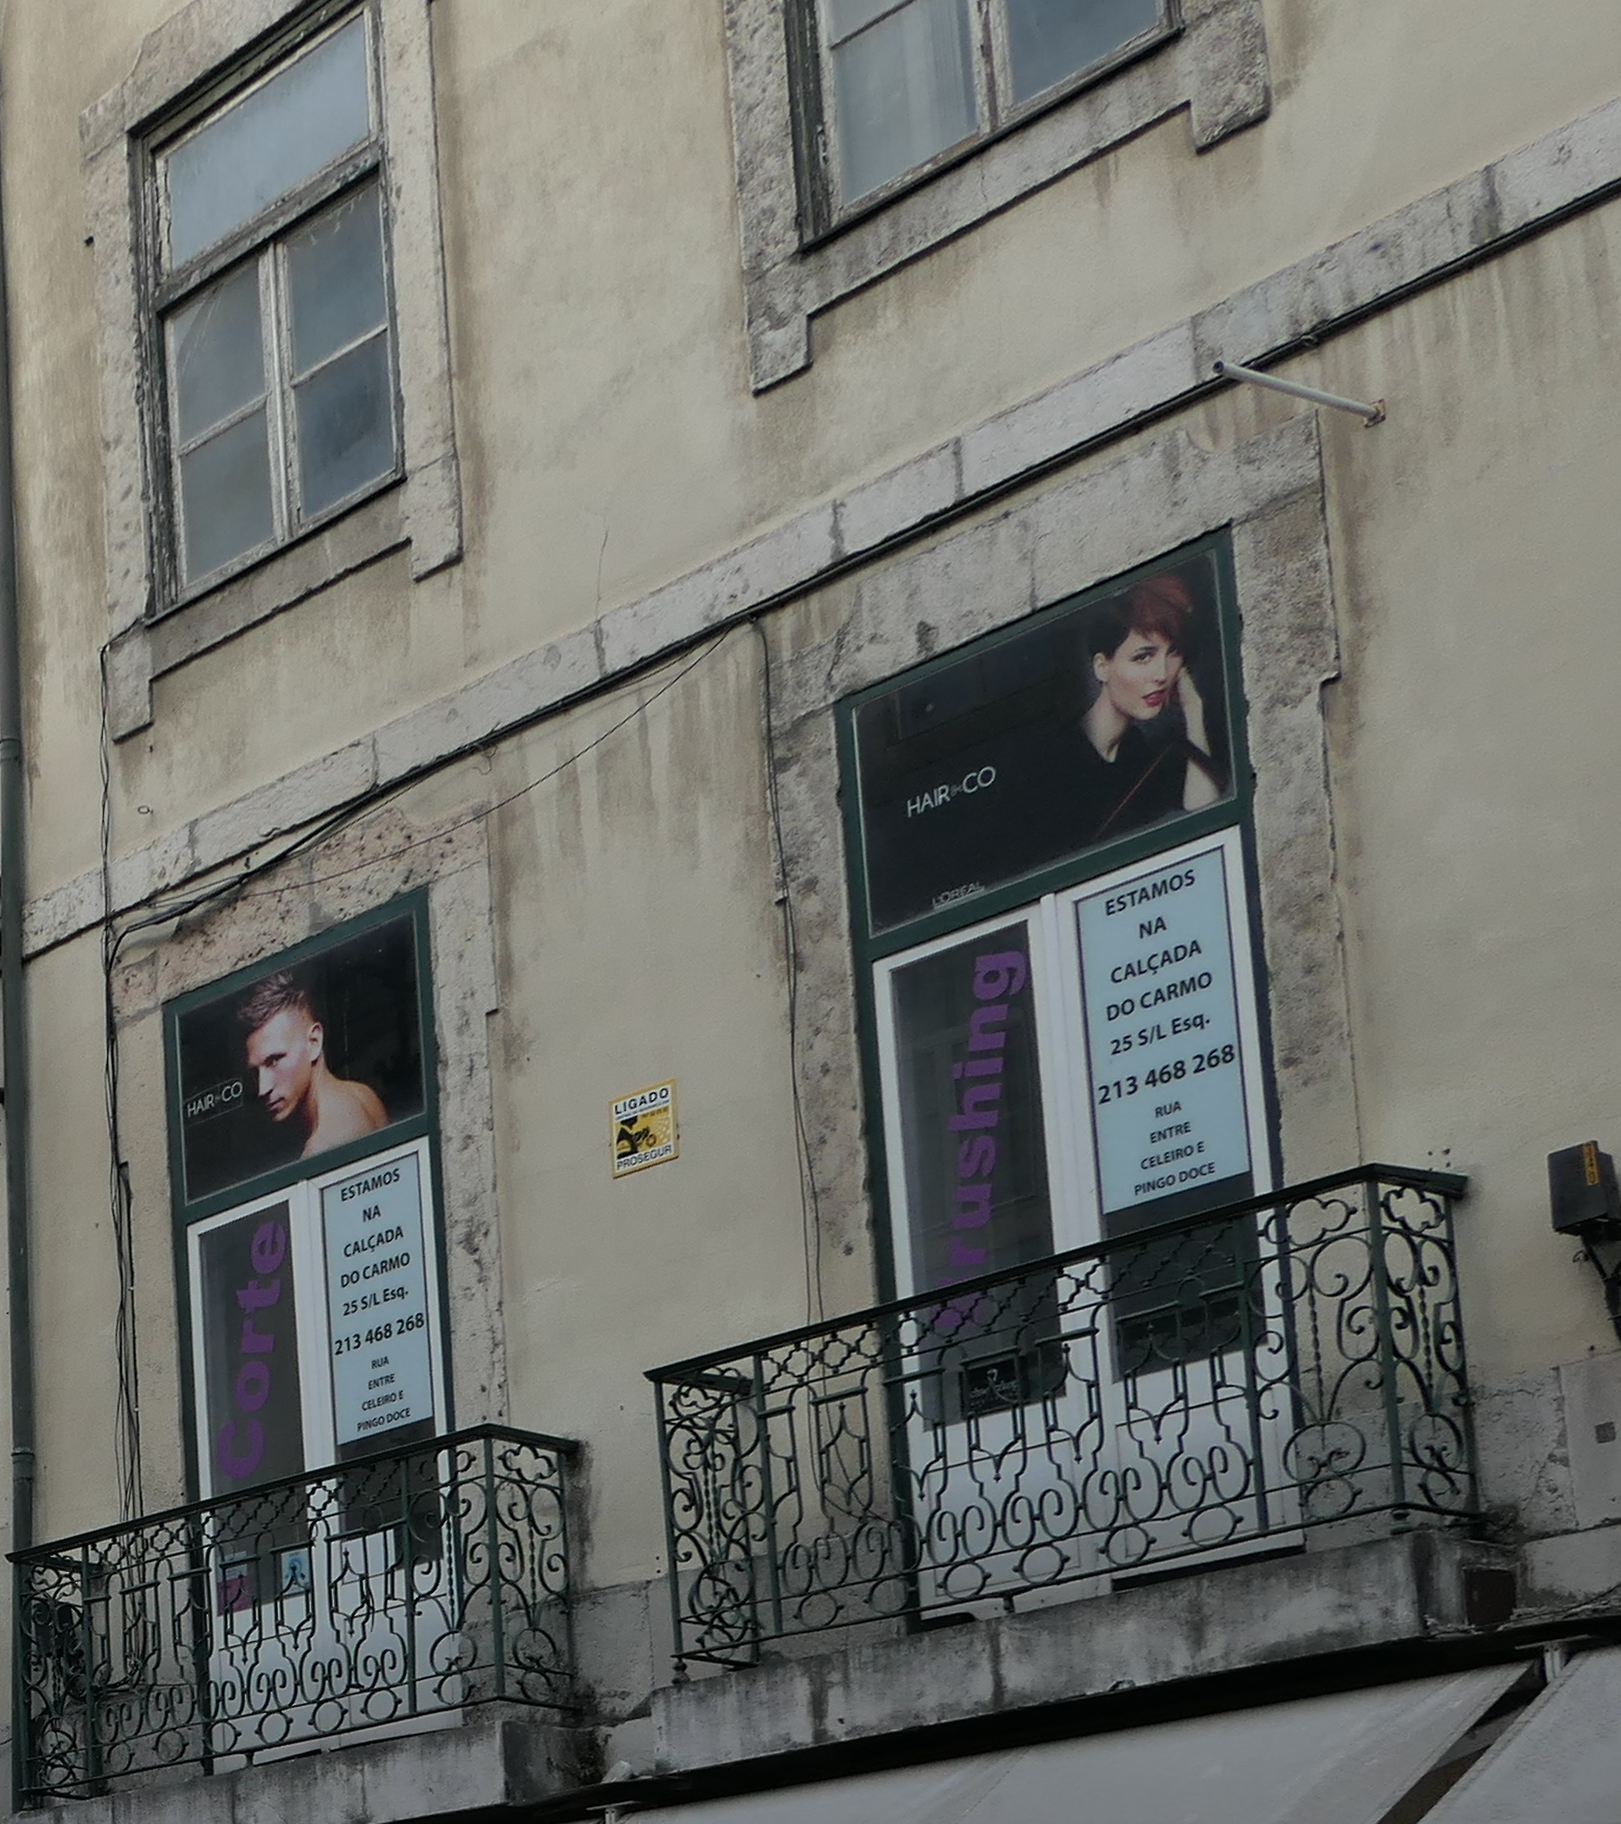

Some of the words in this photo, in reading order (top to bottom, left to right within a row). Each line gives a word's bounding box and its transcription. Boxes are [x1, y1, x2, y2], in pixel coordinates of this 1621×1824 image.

[1105, 868, 1196, 917] ESTAMOS
[1138, 916, 1167, 940] NA
[1111, 939, 1202, 984] CALÇADA
[1106, 1000, 1135, 1022] DO
[1139, 971, 1213, 1013] CARMO
[1110, 1034, 1133, 1056] 25
[1137, 1022, 1167, 1048] S/L
[1171, 1014, 1211, 1041] Esq.
[1098, 1076, 1139, 1105] 213
[1144, 1059, 1187, 1089] 468
[1192, 1044, 1236, 1075] 268
[614, 1087, 669, 1115] LIGADO
[1155, 1100, 1182, 1119] RUA
[1150, 1121, 1192, 1144] ENTRE
[616, 1144, 672, 1171] PROSEGUR
[1140, 1143, 1194, 1171] CELEIRO
[1196, 1140, 1206, 1155] E
[341, 1167, 400, 1202] ESTAMOS
[1134, 1174, 1175, 1197] PINGO
[1178, 1160, 1216, 1186] DOCE
[362, 1204, 381, 1222] NA
[343, 1225, 404, 1258] CALÇADA
[341, 1267, 360, 1288] DO
[362, 1252, 410, 1281] CARMO
[343, 1300, 358, 1317] 25
[361, 1293, 381, 1312] S/L
[383, 1286, 409, 1303] Esq.
[334, 1333, 362, 1356] 213
[365, 1322, 392, 1346] 468
[396, 1312, 424, 1336] 268
[217, 1221, 287, 1479] Corte
[371, 1355, 389, 1370] RUA
[368, 1373, 395, 1391] ENTRE
[361, 1394, 397, 1412] CELEIRO
[357, 1414, 385, 1432] PINGO
[386, 1407, 411, 1425] DOCE
